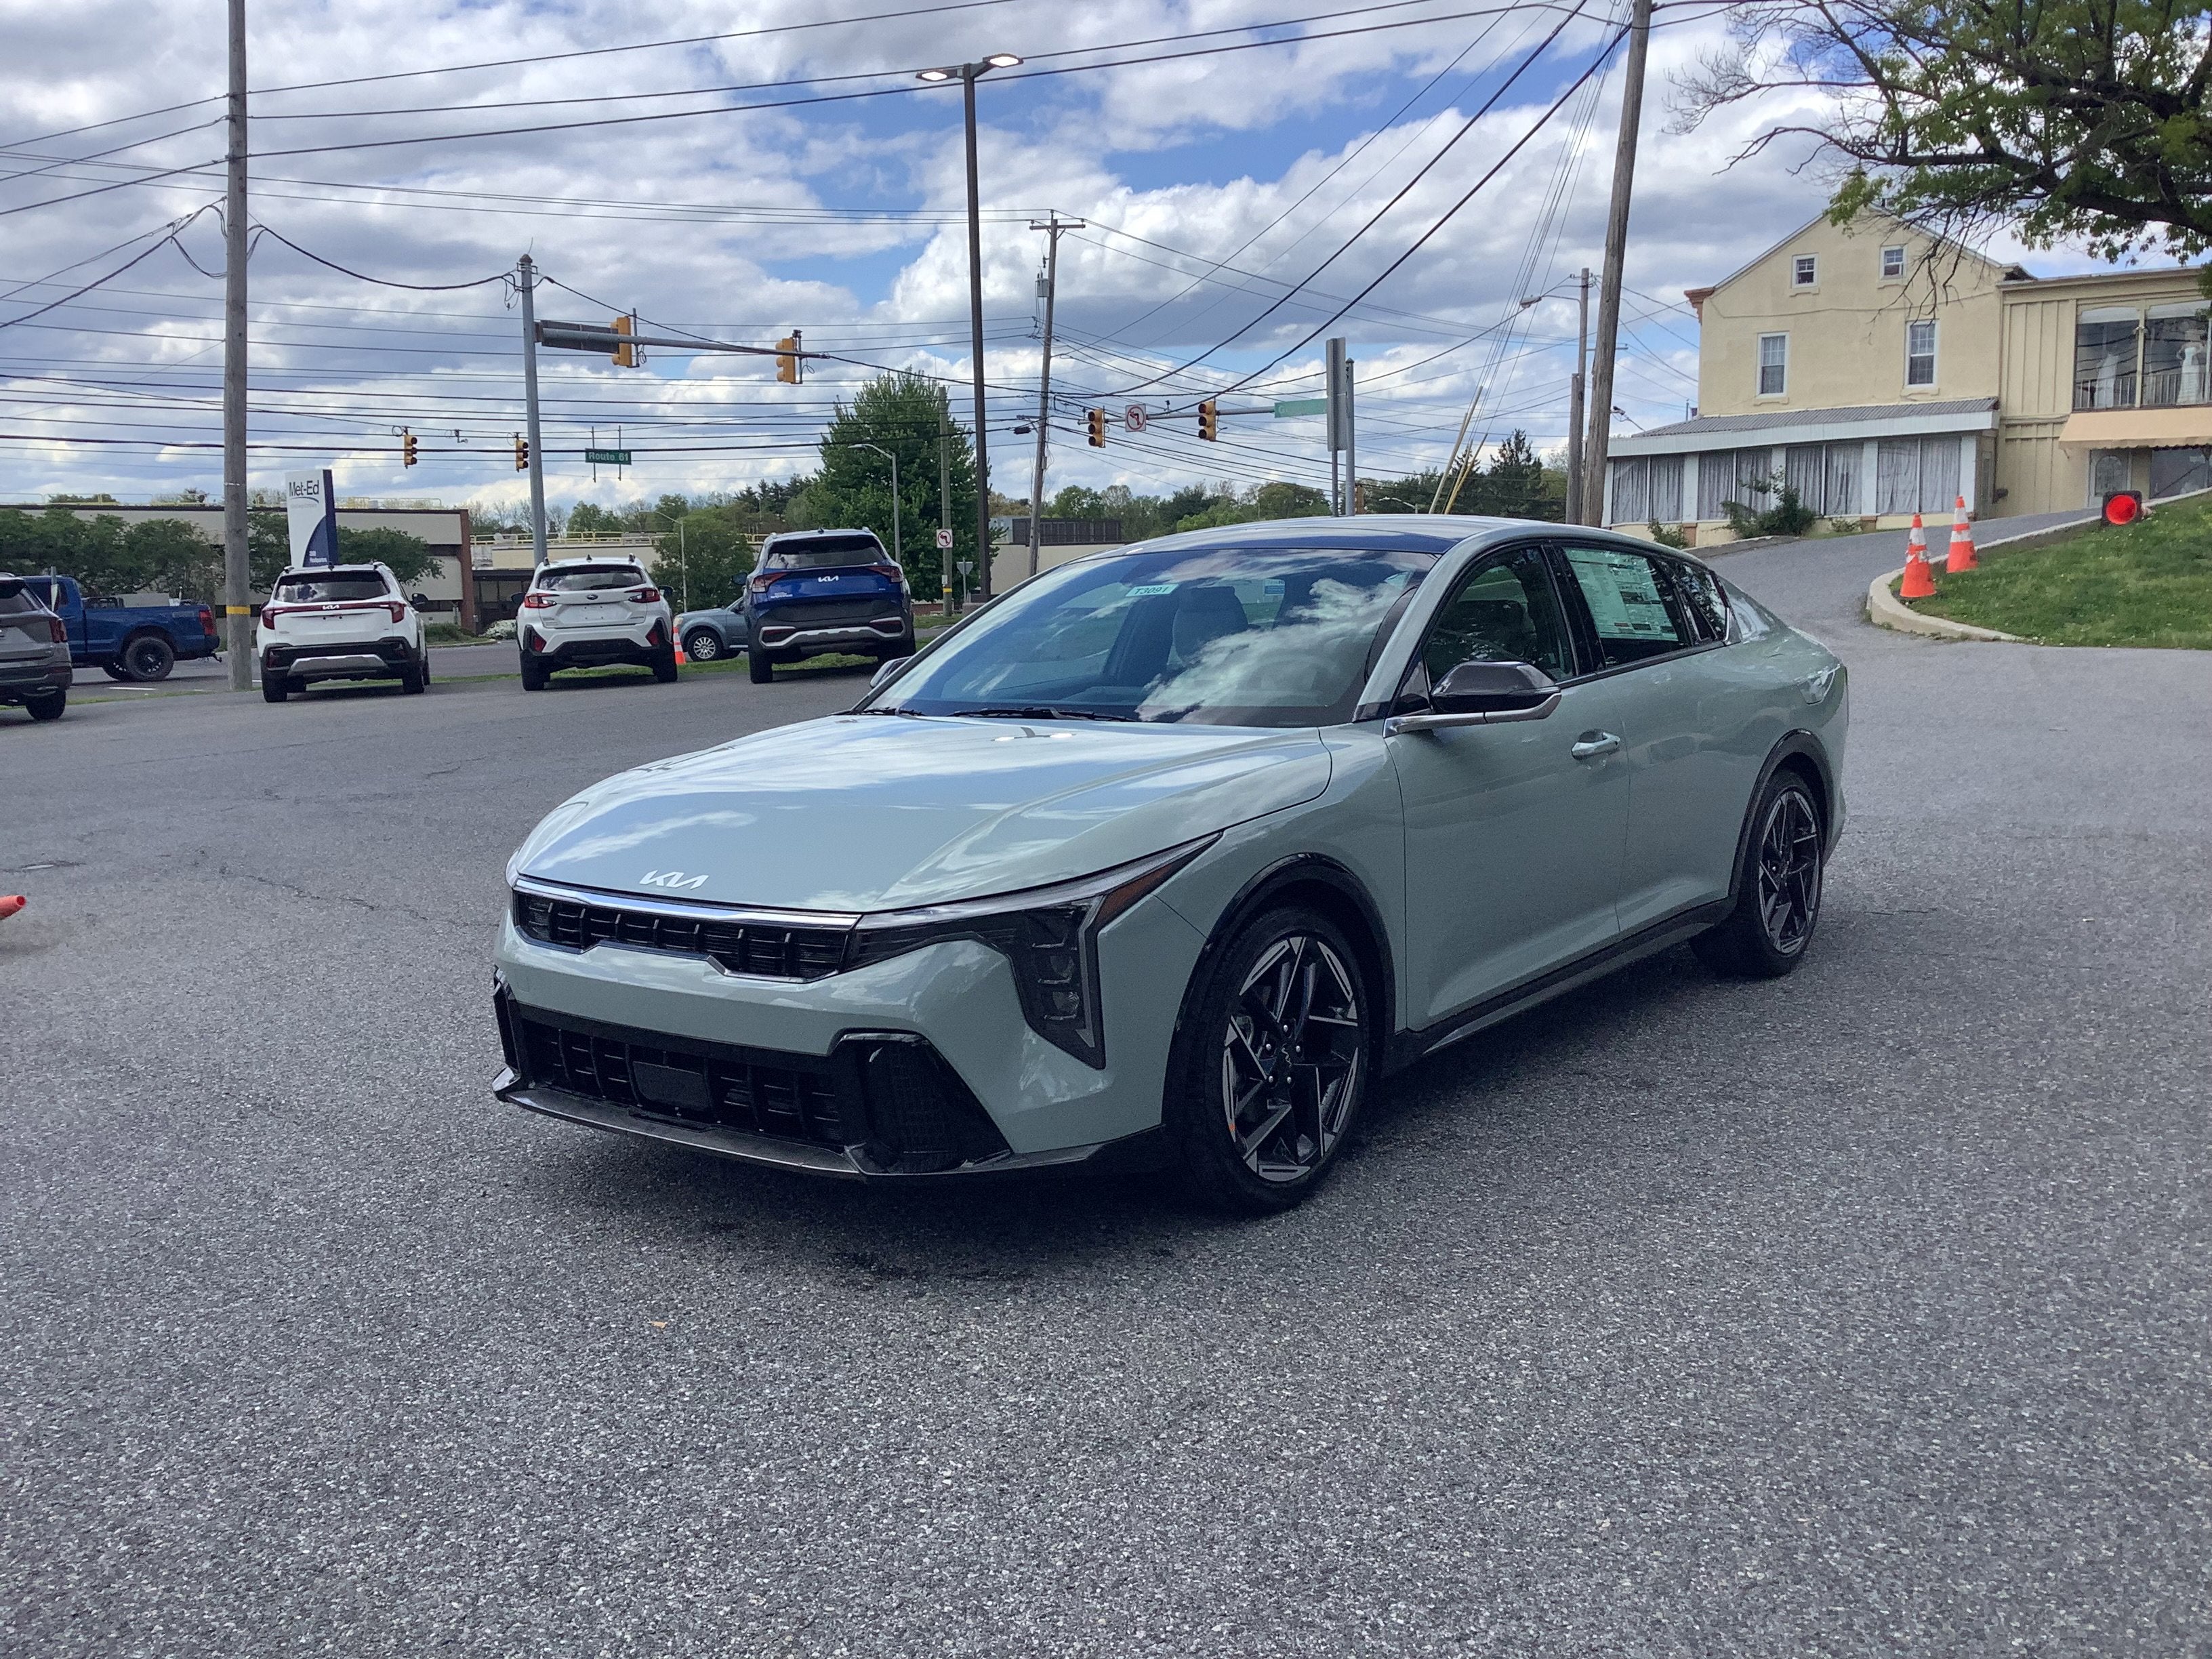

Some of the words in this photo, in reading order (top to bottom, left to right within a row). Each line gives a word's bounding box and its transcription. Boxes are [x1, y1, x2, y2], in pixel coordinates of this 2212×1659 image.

[618, 453, 629, 462] 61
[289, 479, 319, 497] Met-Ed
[1134, 586, 1169, 595] T3091
